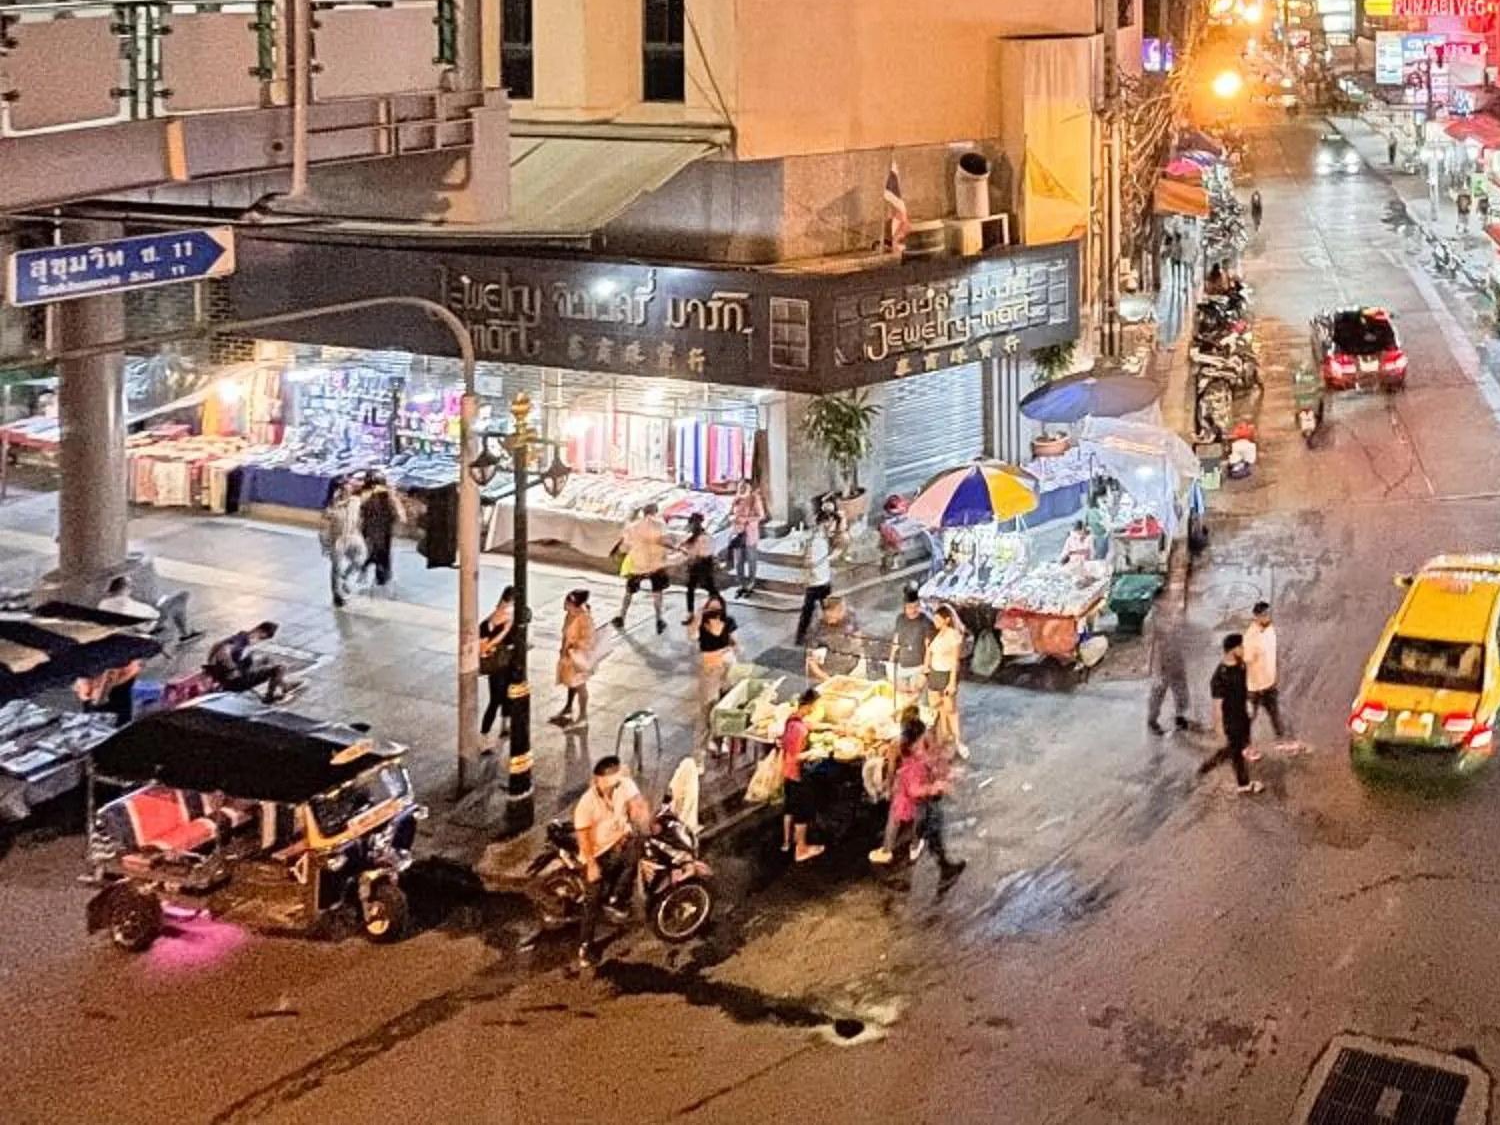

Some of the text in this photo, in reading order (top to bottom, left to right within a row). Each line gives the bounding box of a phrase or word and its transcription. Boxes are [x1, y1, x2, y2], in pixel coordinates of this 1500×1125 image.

[29, 246, 125, 283] สุขุมวิท
[867, 295, 1046, 361] Jewelry mart
